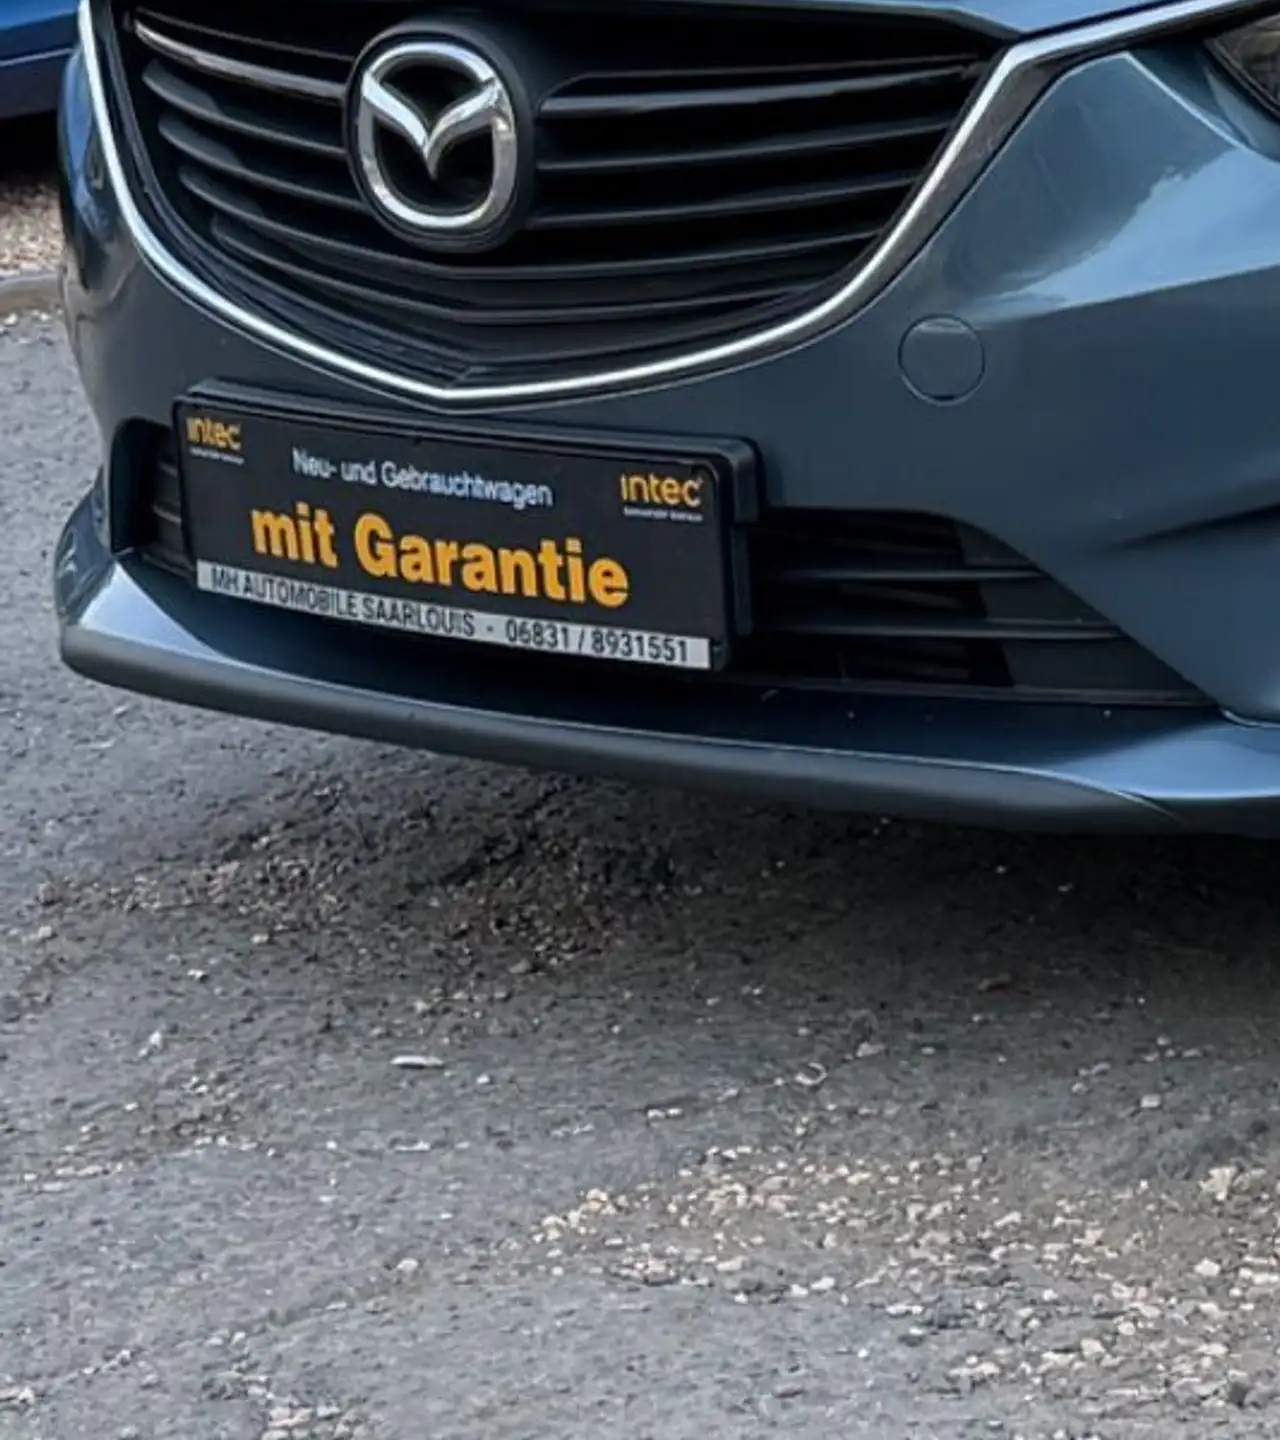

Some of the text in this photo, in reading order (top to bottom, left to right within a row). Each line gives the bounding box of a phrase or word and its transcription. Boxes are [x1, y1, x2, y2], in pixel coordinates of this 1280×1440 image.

[186, 417, 242, 451] intec
[292, 447, 554, 510] Neu- und Gebrauchtwagen
[620, 473, 703, 507] intec
[251, 502, 631, 608] mit Garantie
[211, 564, 238, 590] MH
[244, 572, 360, 619] AUTOMOBILE
[362, 597, 476, 637] SAARLOUIS
[505, 618, 570, 650] 06831
[591, 630, 688, 664] 8931551
